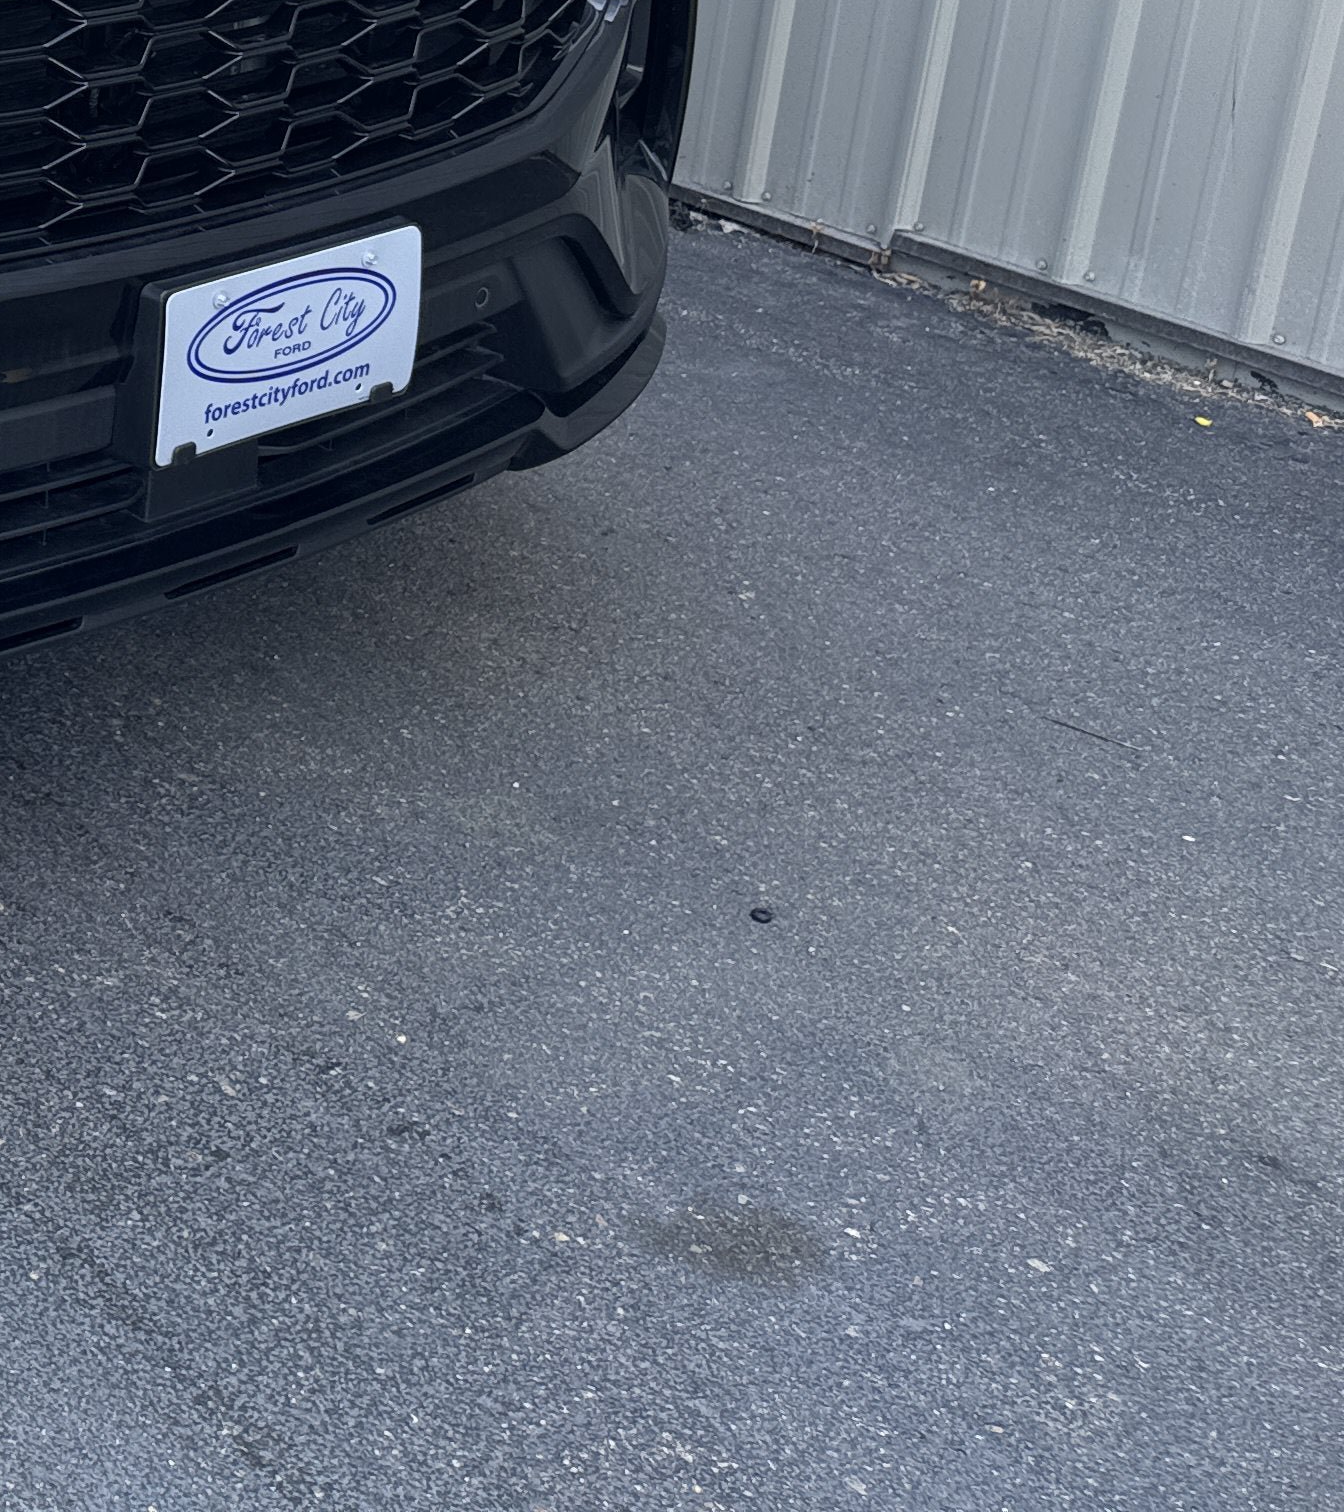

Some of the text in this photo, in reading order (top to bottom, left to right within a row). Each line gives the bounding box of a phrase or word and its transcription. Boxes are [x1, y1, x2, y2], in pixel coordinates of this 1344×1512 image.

[223, 287, 367, 355] Forest City
[274, 340, 312, 359] FORD
[204, 362, 370, 424] forestcityford.com
